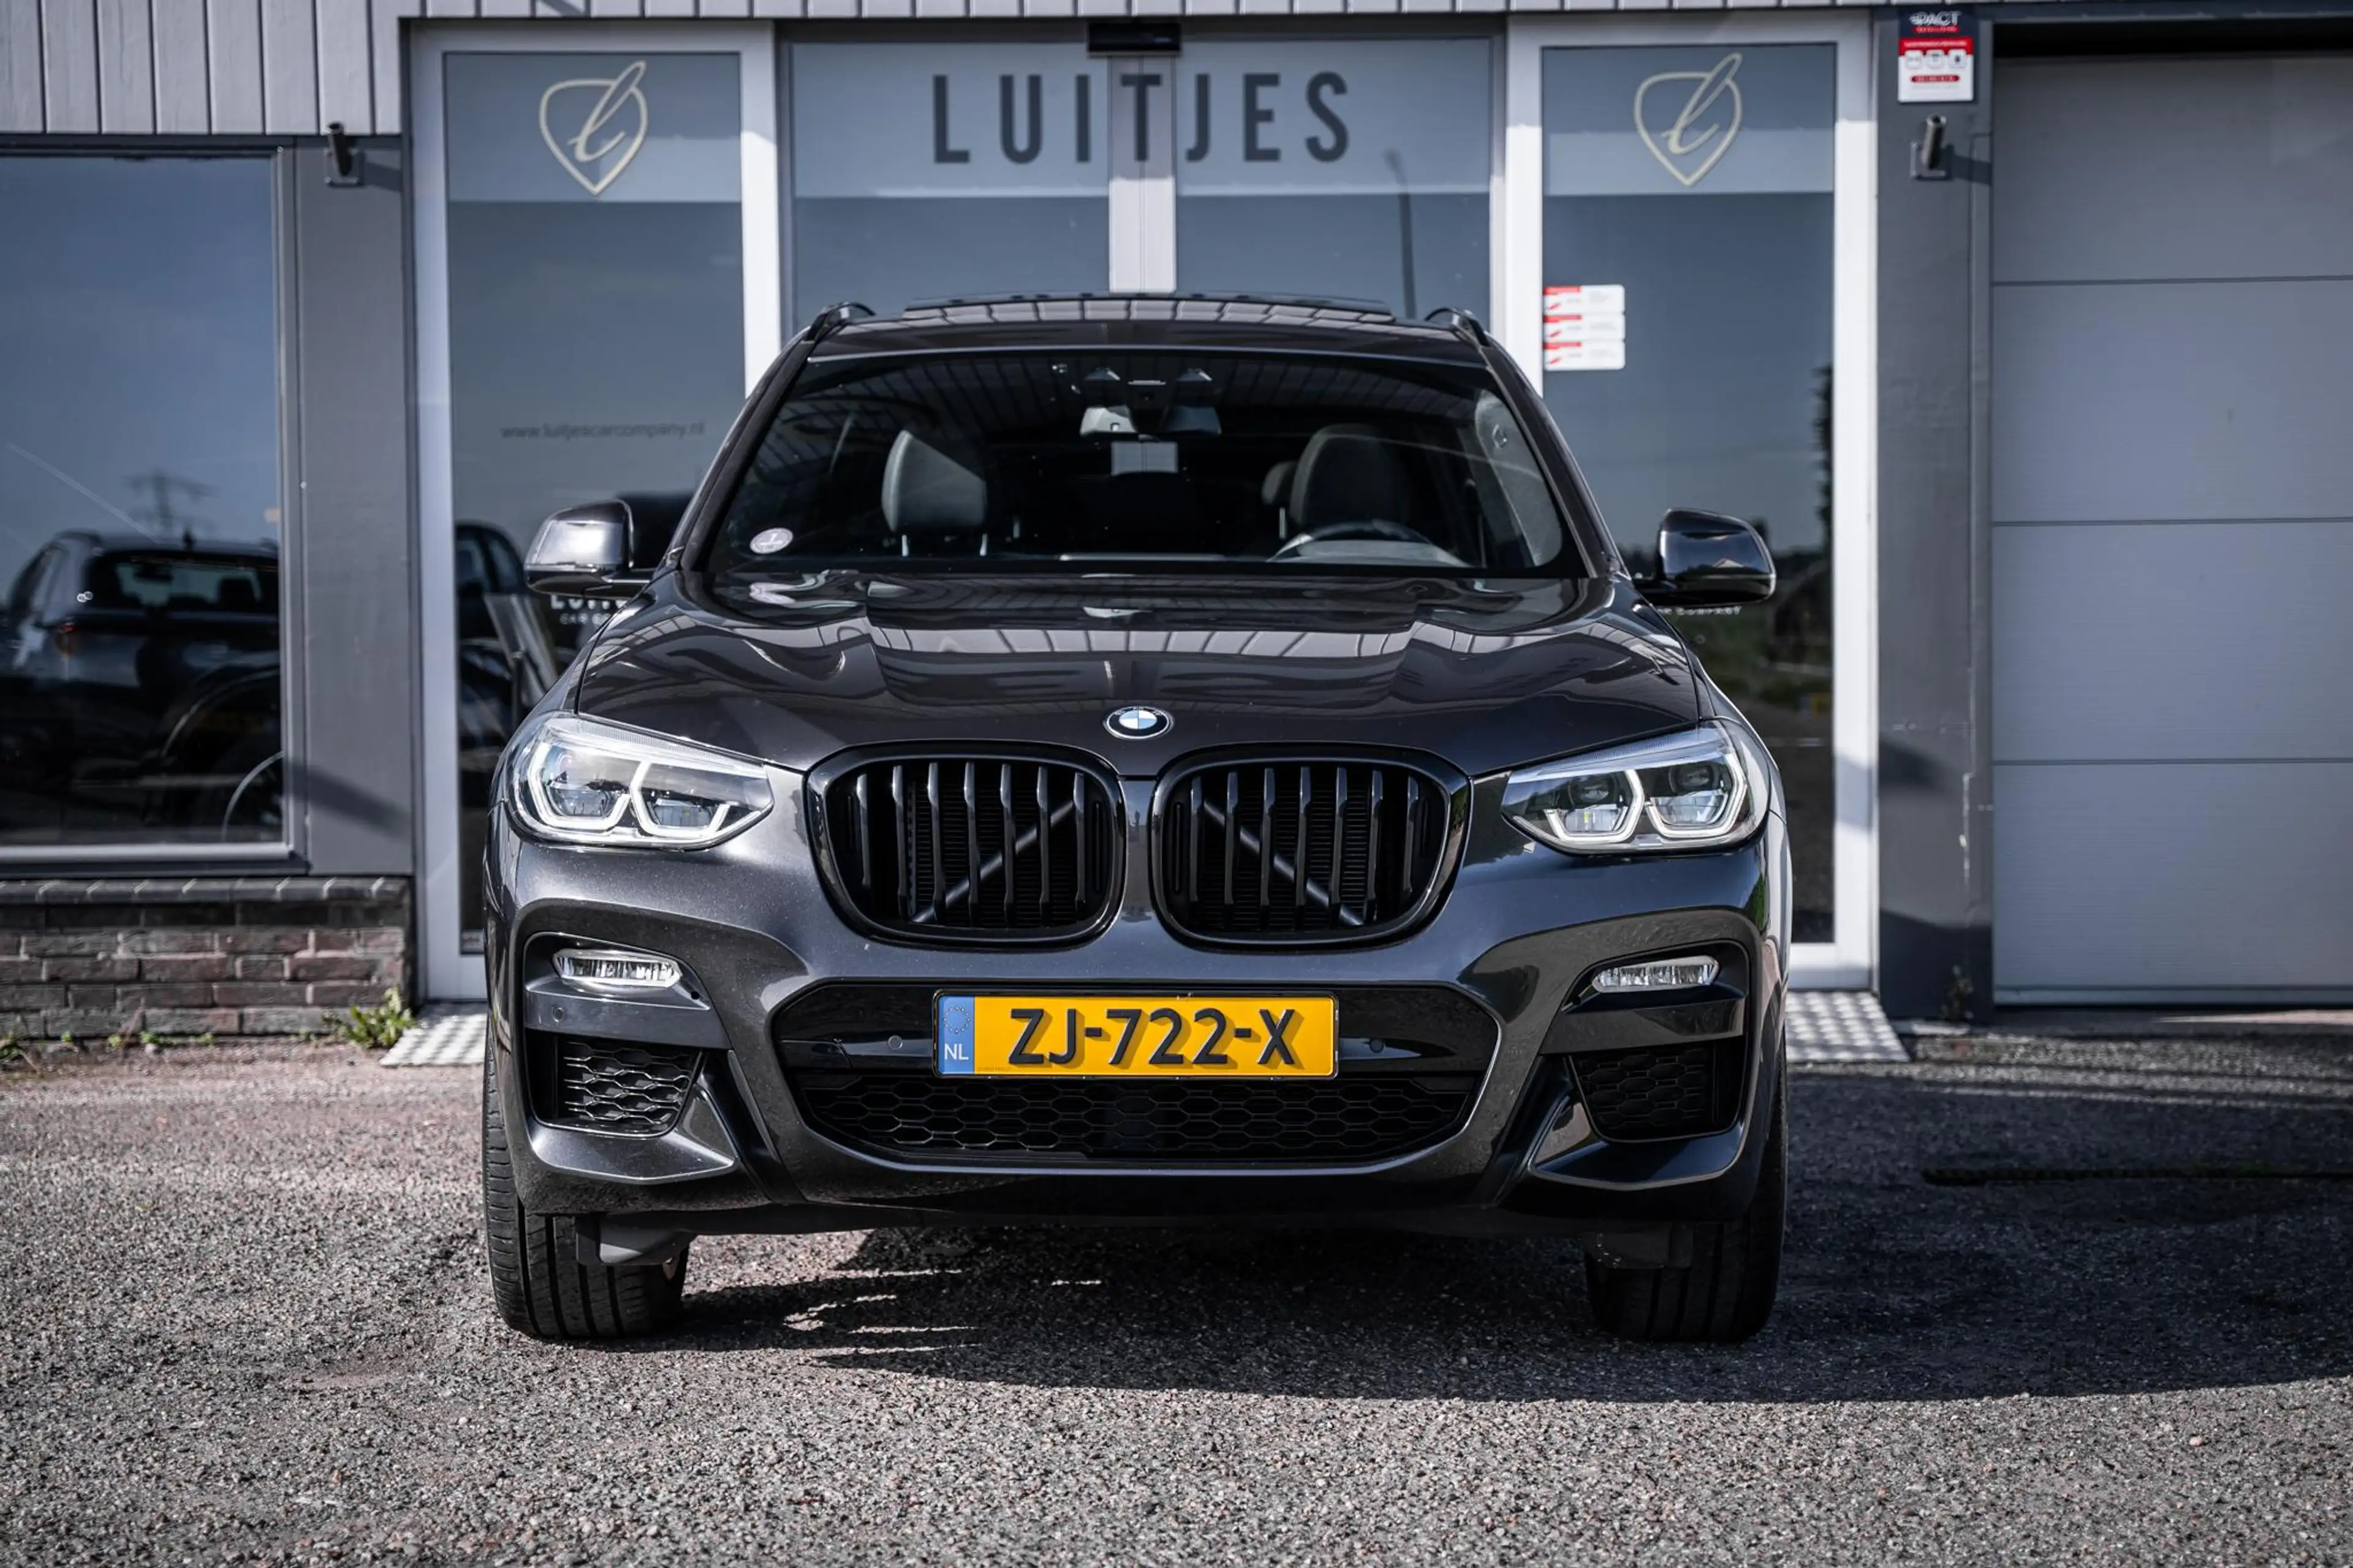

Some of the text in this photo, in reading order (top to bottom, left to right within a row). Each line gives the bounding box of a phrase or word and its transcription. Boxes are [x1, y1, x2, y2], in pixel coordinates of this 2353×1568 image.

[933, 71, 1349, 164] LUITJES
[944, 1007, 1295, 1065] NL ZJ-722-X
